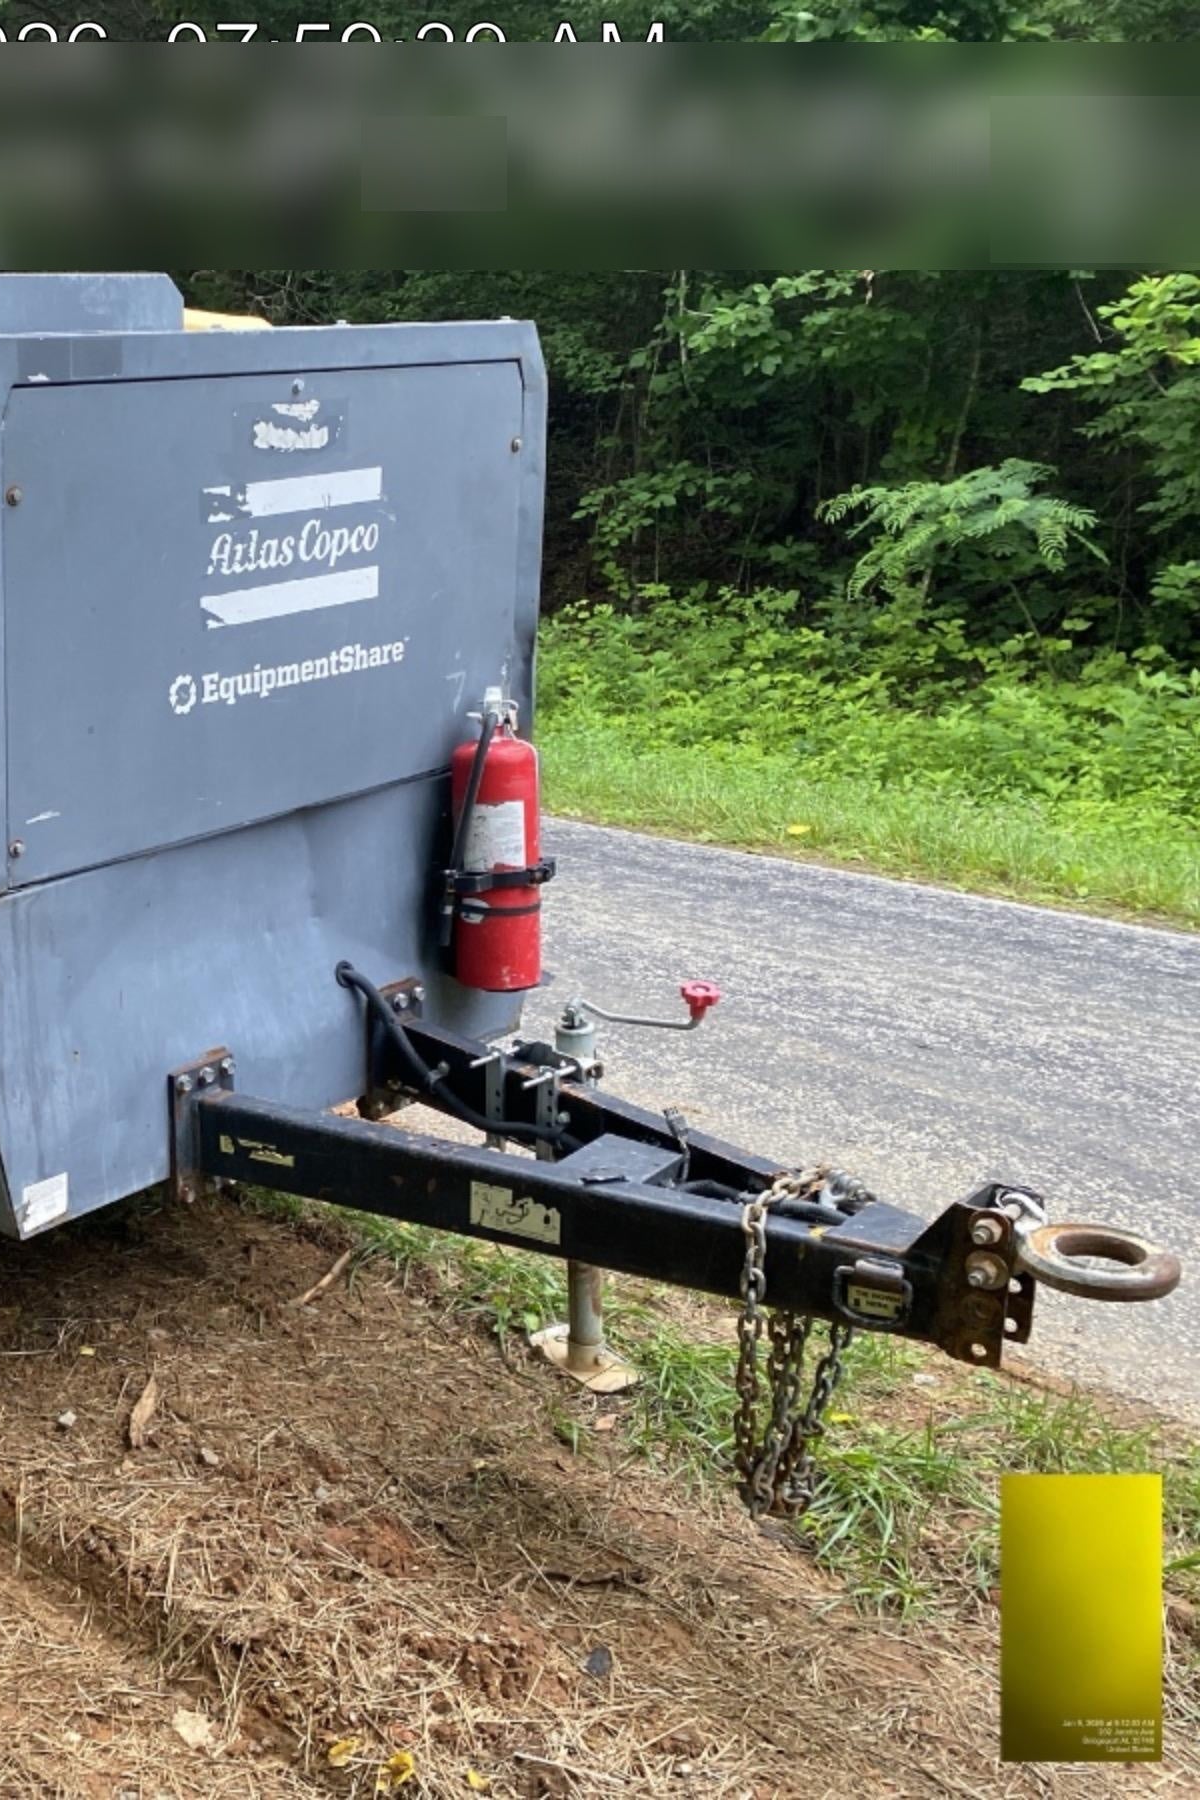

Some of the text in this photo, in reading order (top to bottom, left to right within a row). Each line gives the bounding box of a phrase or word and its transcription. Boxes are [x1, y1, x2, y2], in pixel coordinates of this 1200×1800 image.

[206, 519, 380, 576] Atlas Copco
[201, 640, 405, 705] EquipmentShare
